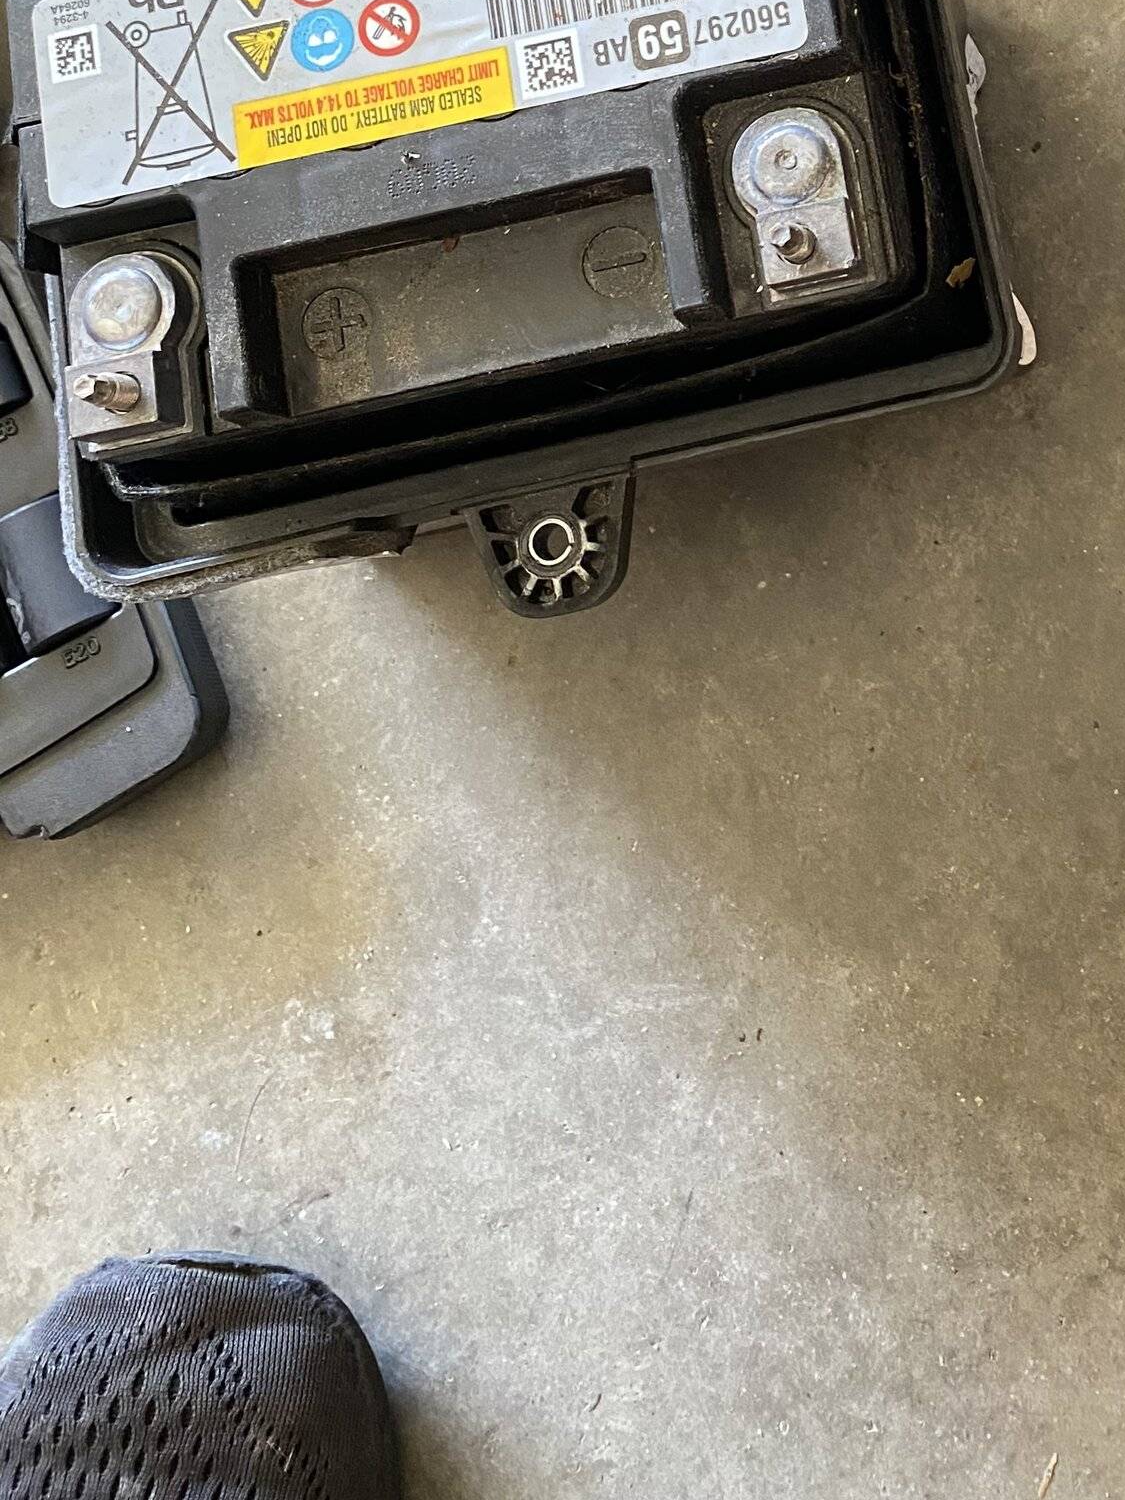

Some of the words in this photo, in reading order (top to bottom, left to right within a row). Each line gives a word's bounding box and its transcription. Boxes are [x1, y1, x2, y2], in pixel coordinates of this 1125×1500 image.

[691, 0, 792, 45] 560297
[591, 35, 631, 66] AB
[633, 16, 685, 61] 59
[416, 66, 465, 93] CHARGE
[466, 58, 500, 82] LIMIT
[341, 89, 360, 109] TO
[360, 76, 416, 105] VOLTAGE
[437, 84, 482, 110] SEALED
[275, 98, 315, 123] VOLTS
[315, 92, 343, 115] 14.4
[350, 100, 407, 129] BATTERY.
[407, 94, 437, 117] AGM
[243, 107, 276, 130] MAX.
[302, 117, 328, 139] NOT
[329, 113, 348, 133] DO
[264, 122, 302, 147] OPEN!
[62, 635, 101, 669] E20
